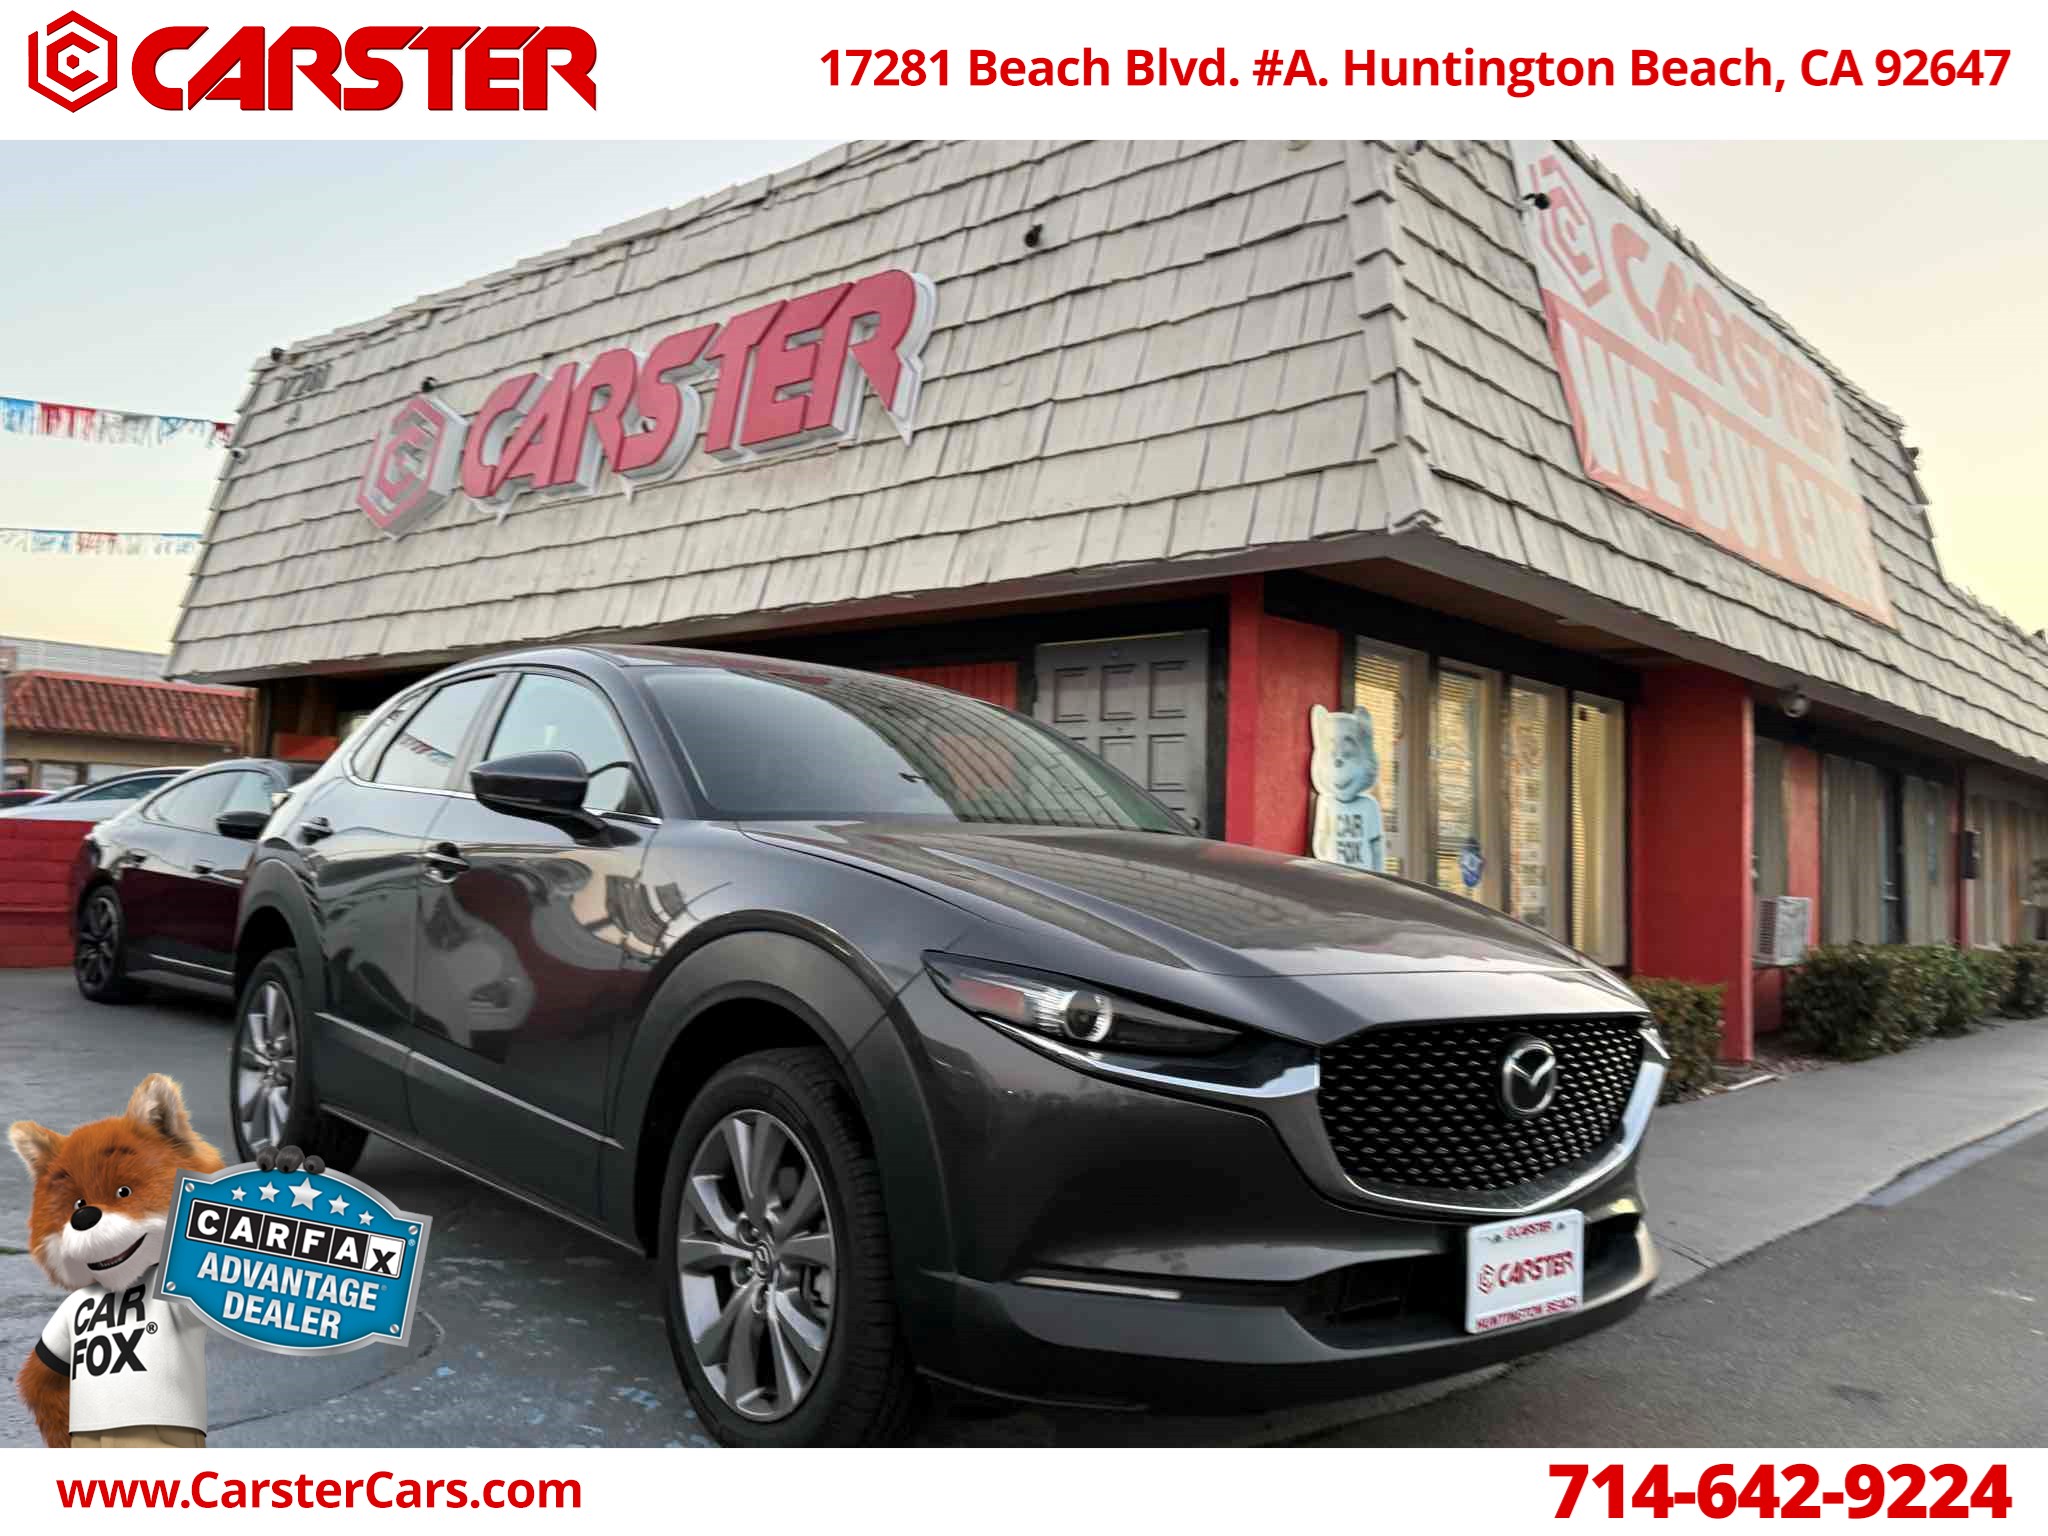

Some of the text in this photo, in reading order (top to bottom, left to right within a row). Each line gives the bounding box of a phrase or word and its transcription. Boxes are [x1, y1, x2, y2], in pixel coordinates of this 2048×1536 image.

[461, 268, 922, 500] CARSTER
[1559, 320, 1686, 508] WE
[1671, 389, 1783, 561] BUY
[1498, 1250, 1574, 1288] CARSTER
